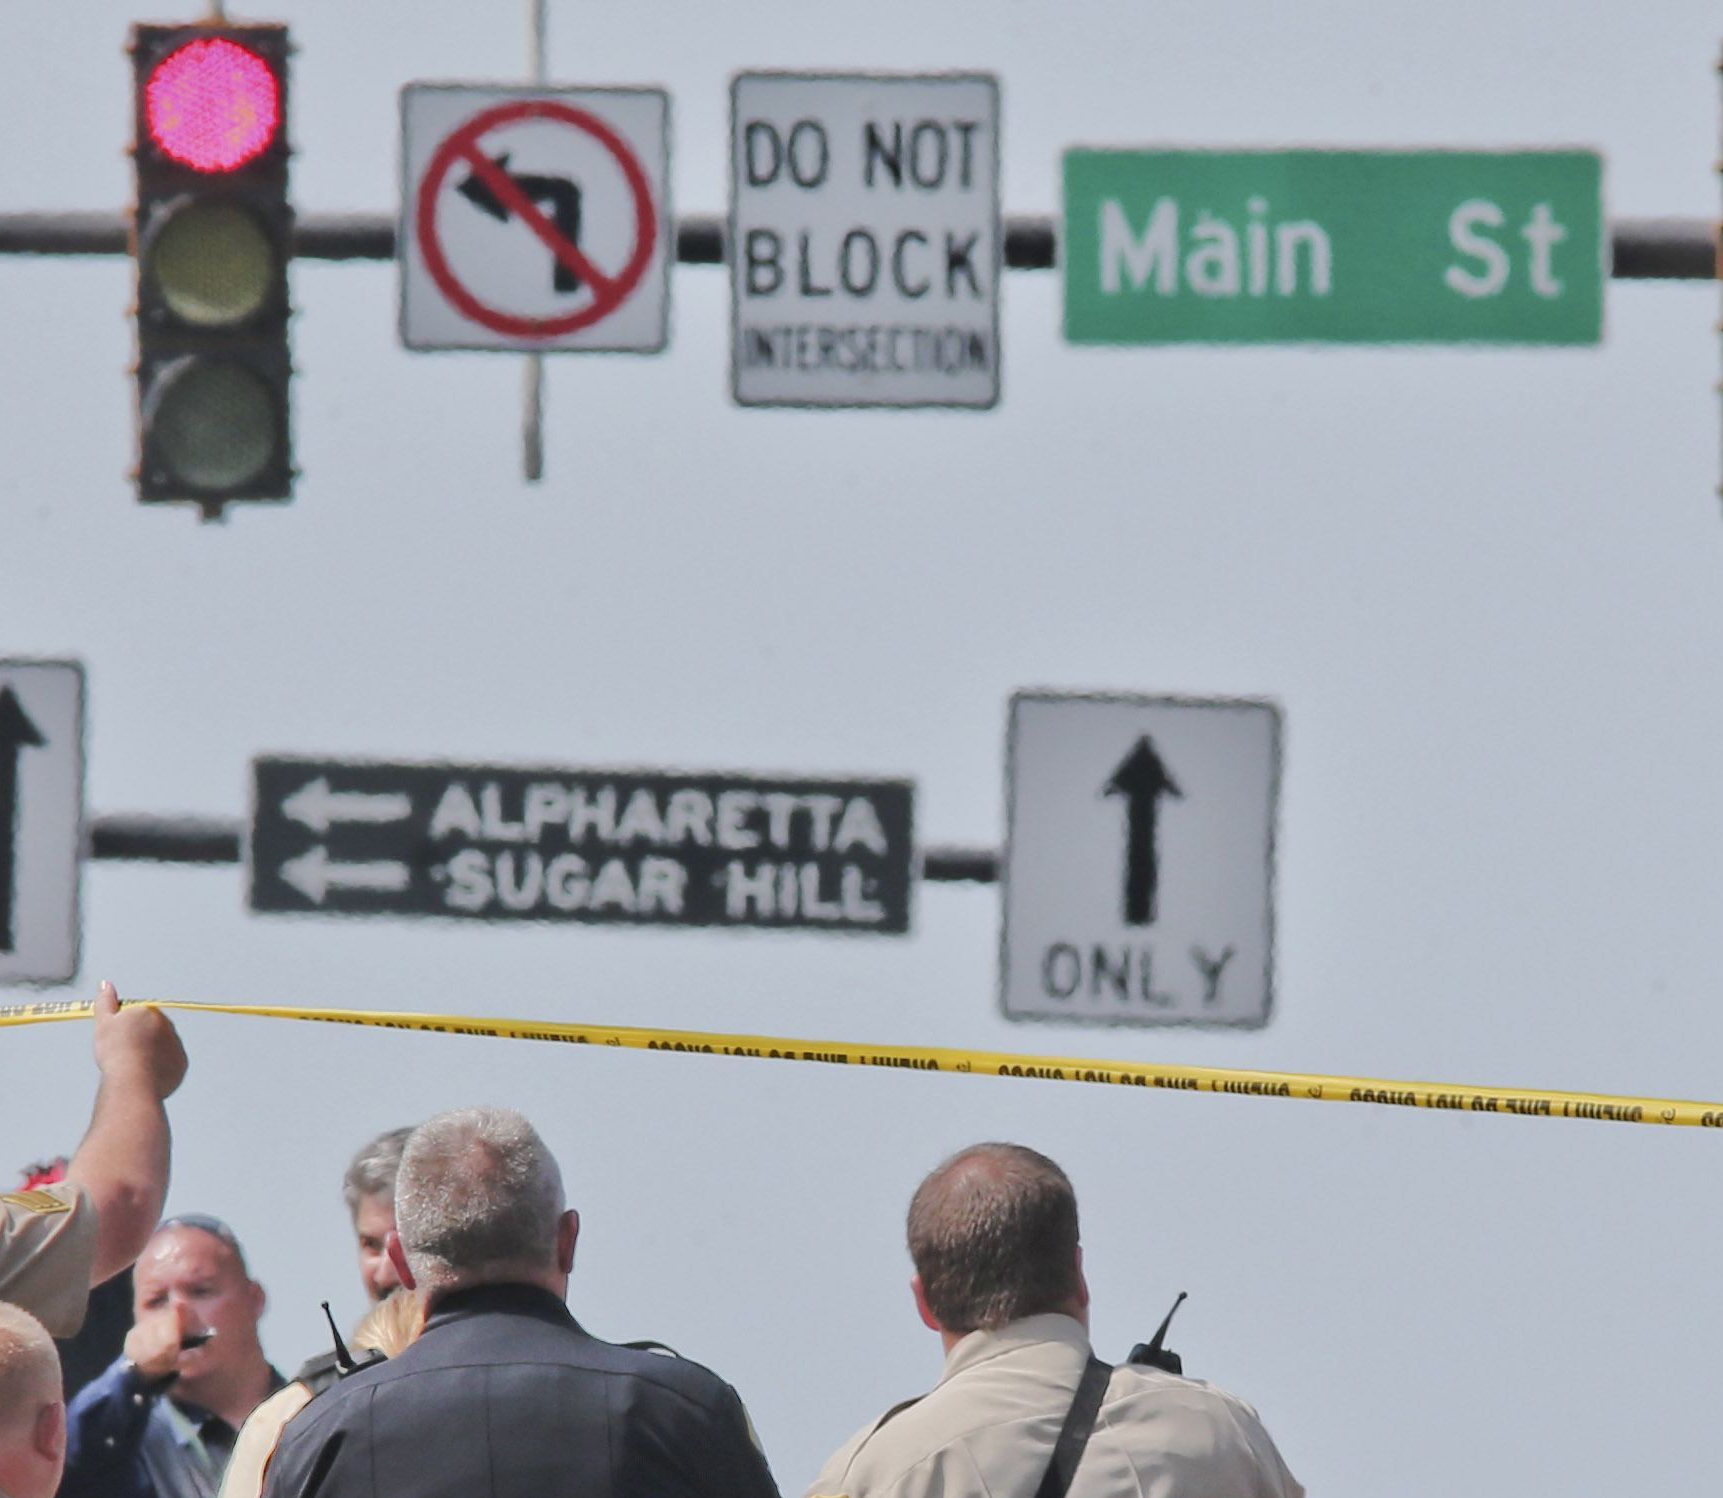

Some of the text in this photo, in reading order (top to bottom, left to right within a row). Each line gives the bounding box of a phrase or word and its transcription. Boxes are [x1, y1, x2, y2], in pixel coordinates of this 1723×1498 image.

[743, 119, 980, 190] DO NOT
[743, 227, 982, 299] BLOCK
[1097, 196, 1566, 298] Main St
[742, 323, 987, 375] INTERSECTION
[429, 780, 884, 859] ALPHARETTA
[441, 848, 887, 923] SUGAR HILL
[1040, 941, 1237, 1007] ONLY
